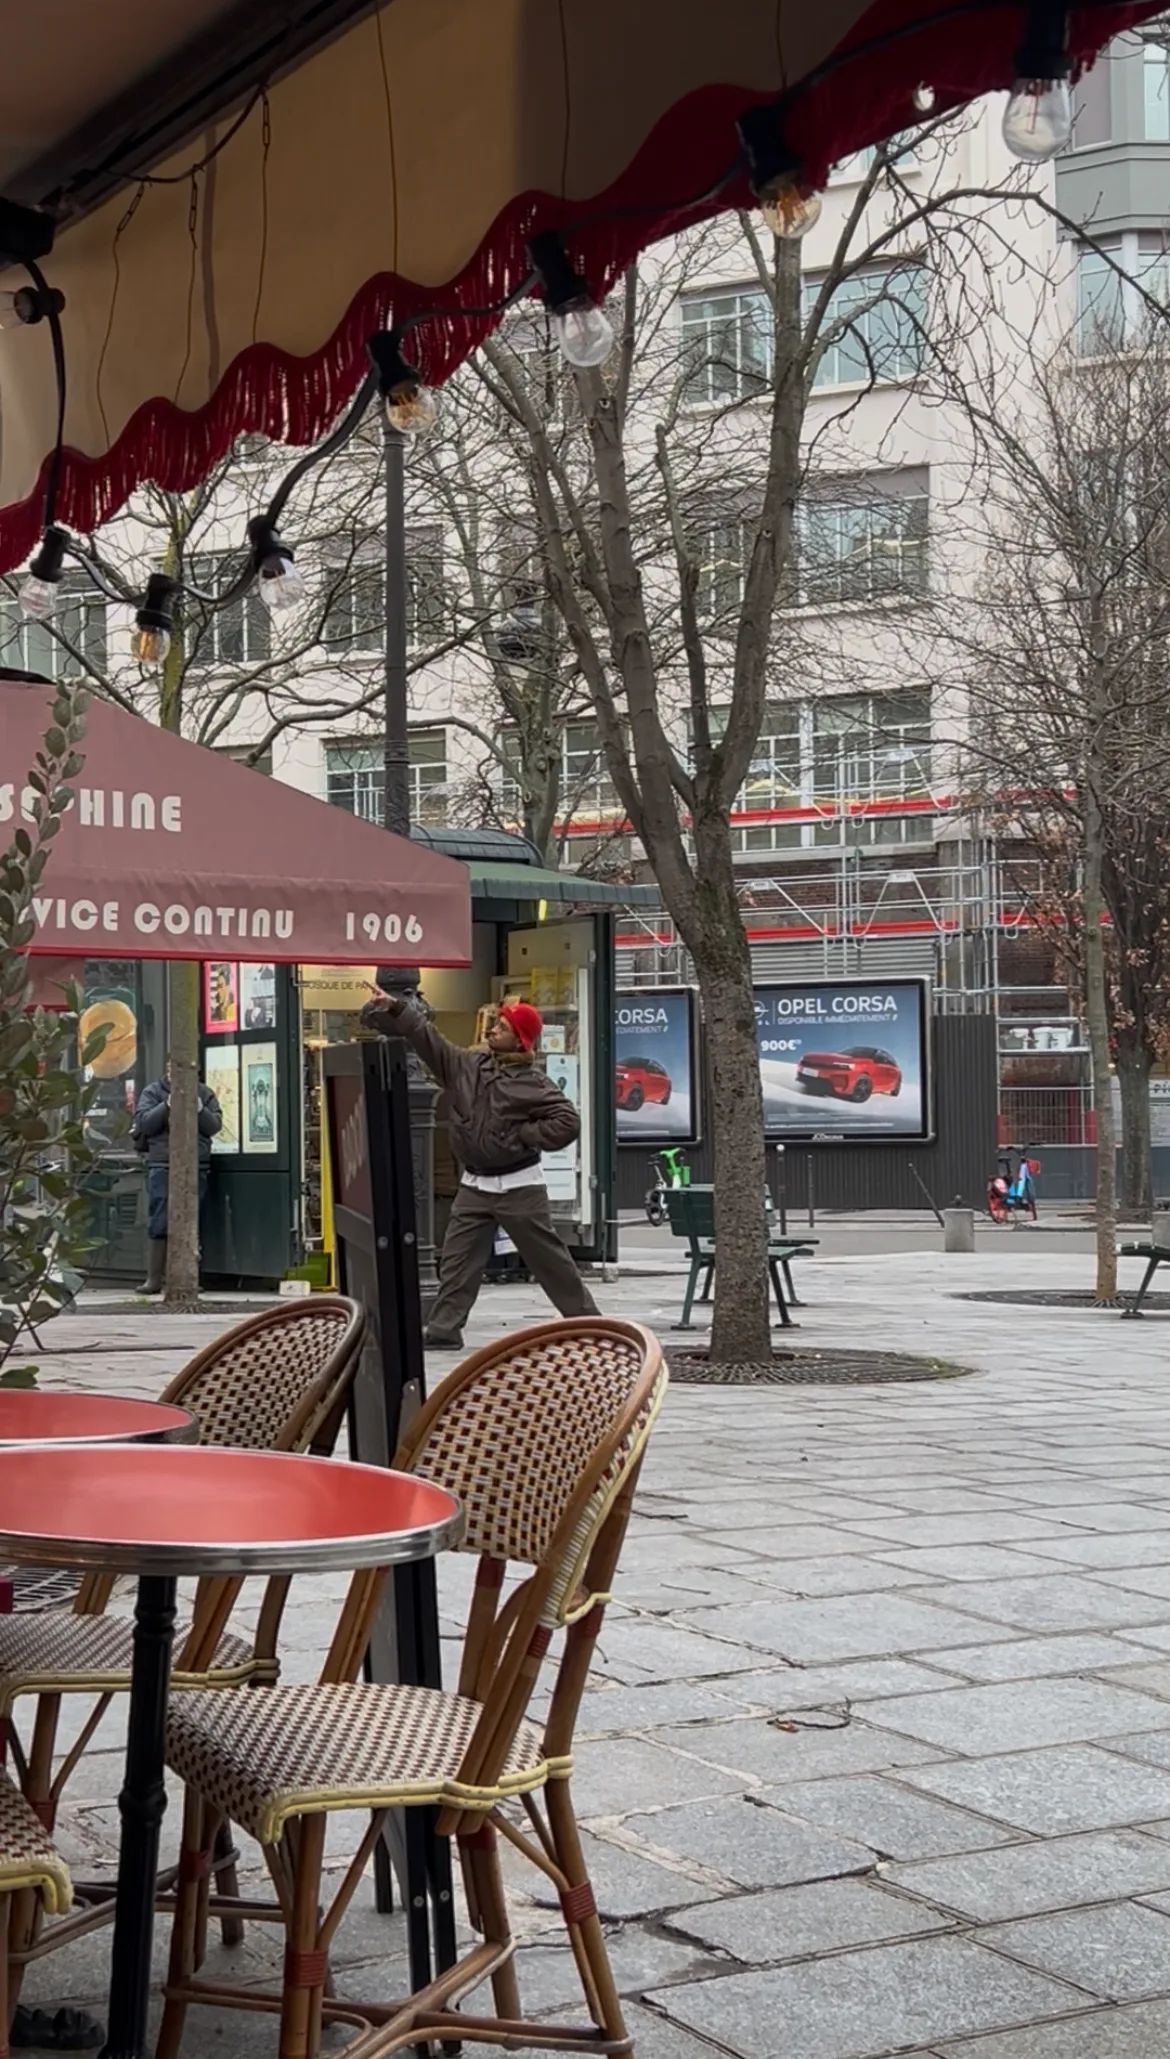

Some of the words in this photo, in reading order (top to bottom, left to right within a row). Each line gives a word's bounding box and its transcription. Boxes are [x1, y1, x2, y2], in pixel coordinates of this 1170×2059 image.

[18, 898, 119, 931] VICE
[134, 903, 294, 938] CONTINU
[346, 912, 423, 943] 1906
[341, 981, 354, 990] DE
[778, 998, 827, 1015] OPEL
[832, 996, 897, 1013] CORSA
[615, 1008, 668, 1025] ORSA
